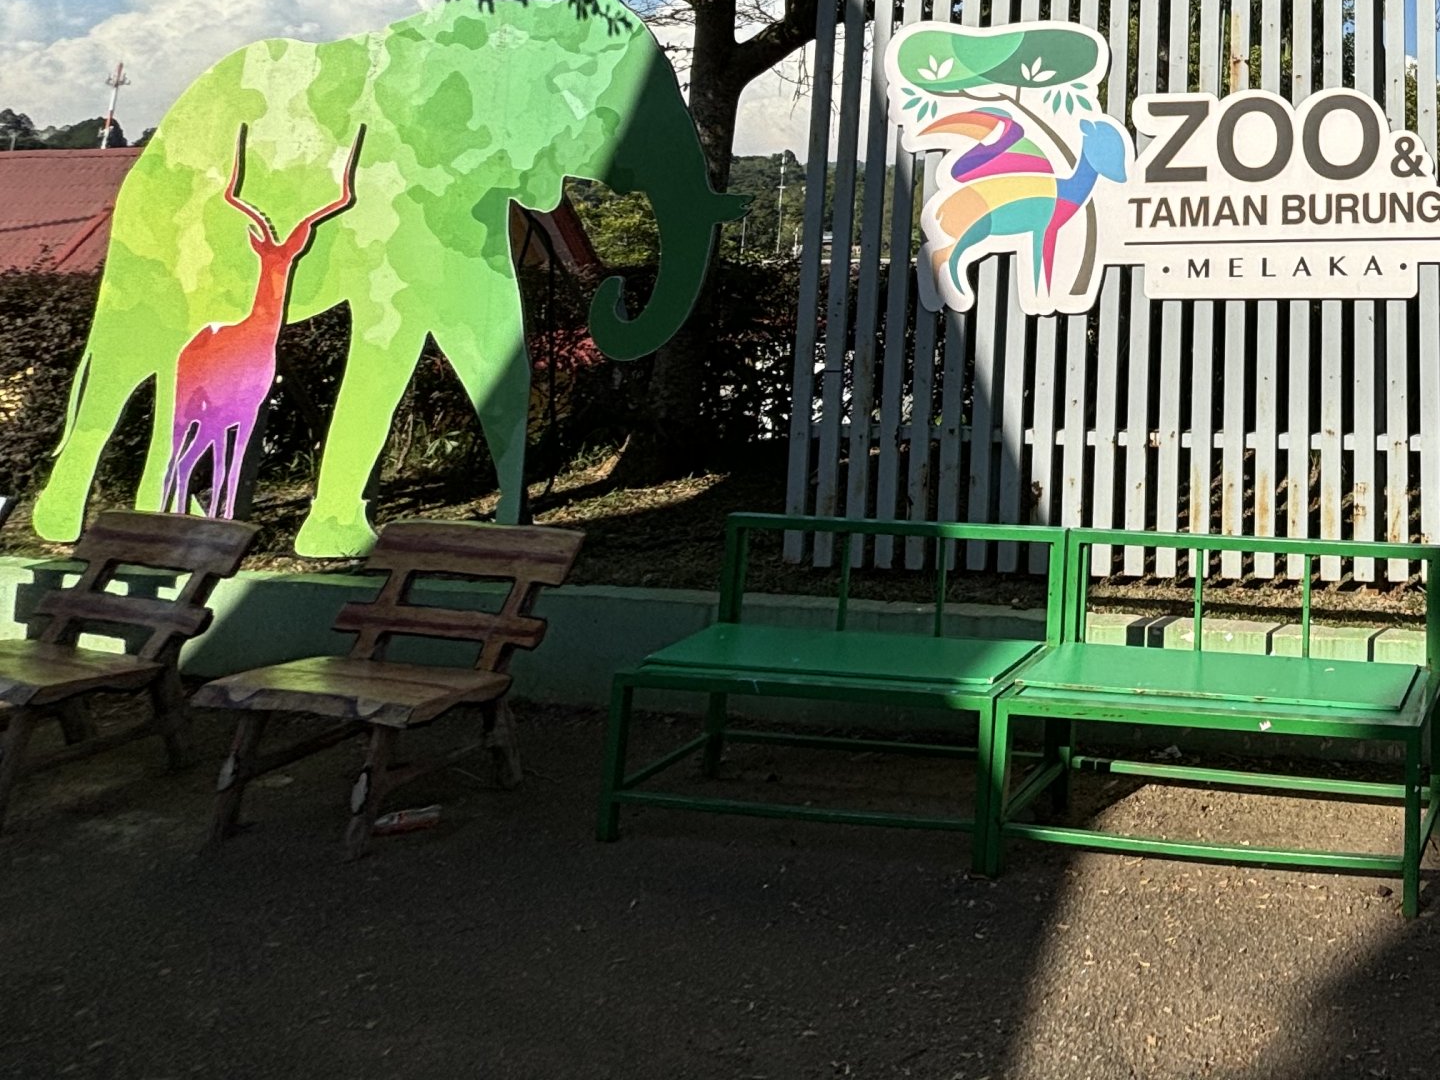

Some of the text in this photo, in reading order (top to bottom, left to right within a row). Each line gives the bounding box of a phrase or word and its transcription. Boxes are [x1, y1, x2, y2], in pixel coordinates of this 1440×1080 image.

[1145, 94, 1427, 183] ZOO &
[1127, 194, 1268, 229] TAMAN
[1186, 255, 1384, 279] MELAKA
